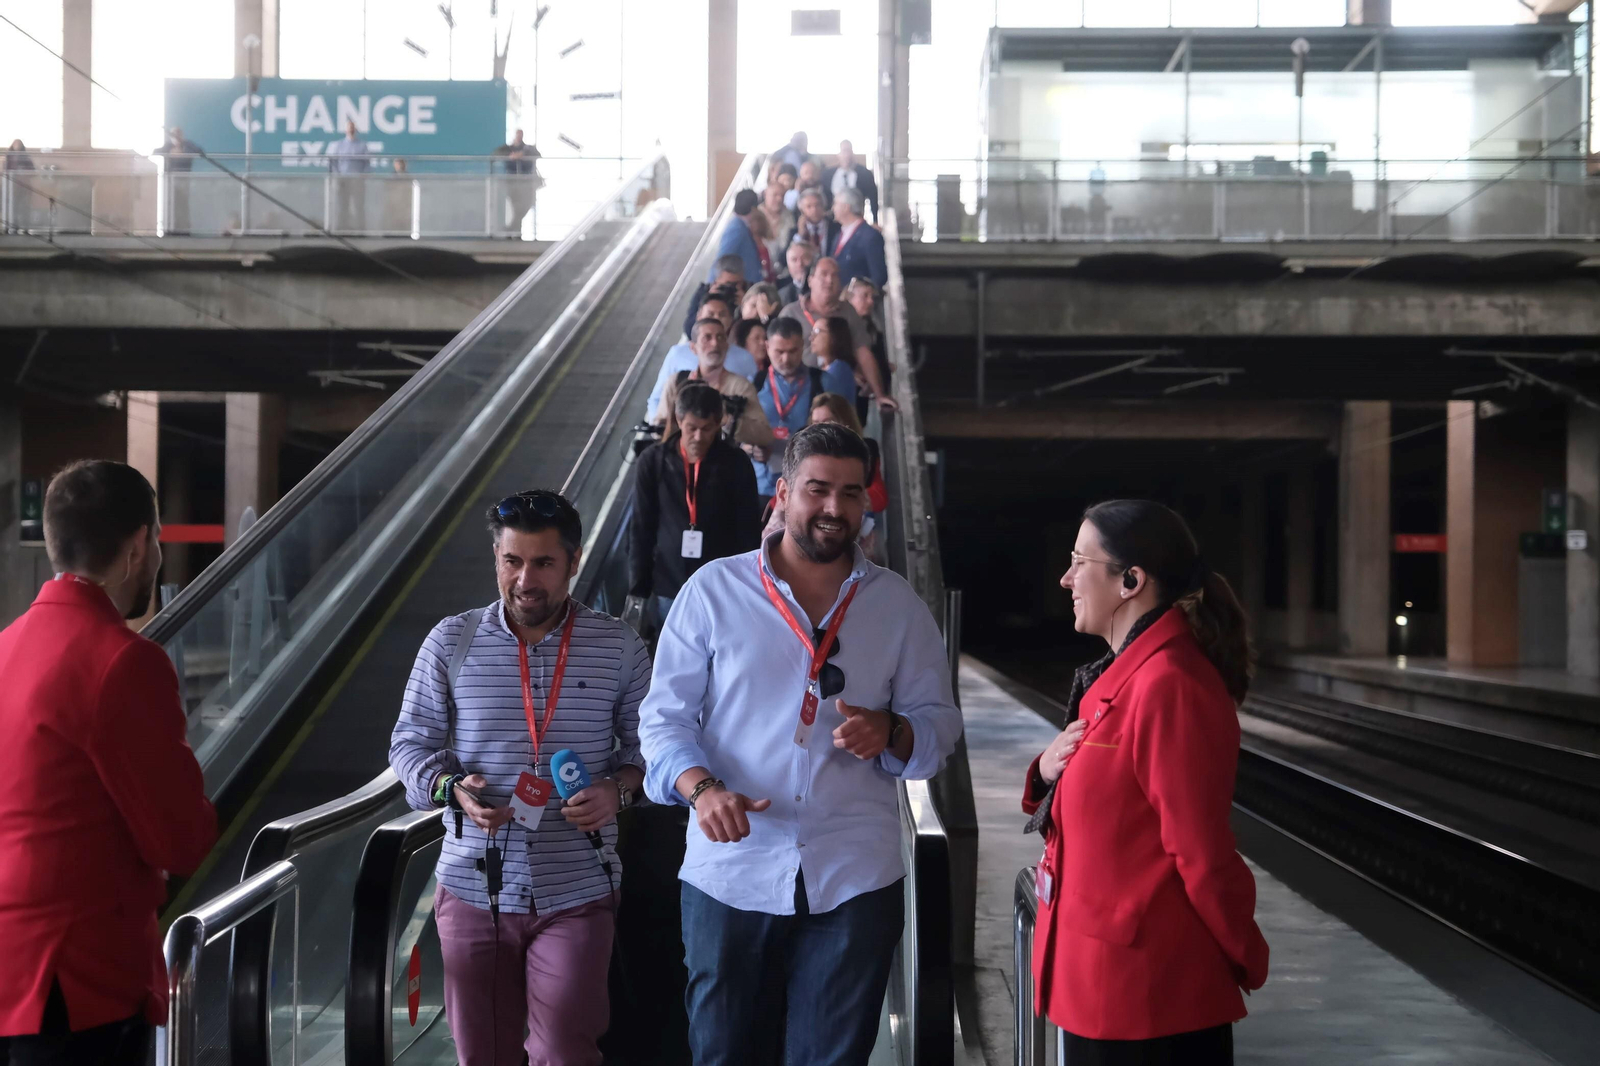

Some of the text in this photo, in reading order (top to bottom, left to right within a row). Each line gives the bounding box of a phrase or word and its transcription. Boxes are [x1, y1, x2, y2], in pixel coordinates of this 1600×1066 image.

[230, 94, 437, 134] CHANGE
[525, 783, 541, 796] iryo
[564, 778, 585, 791] COPE
